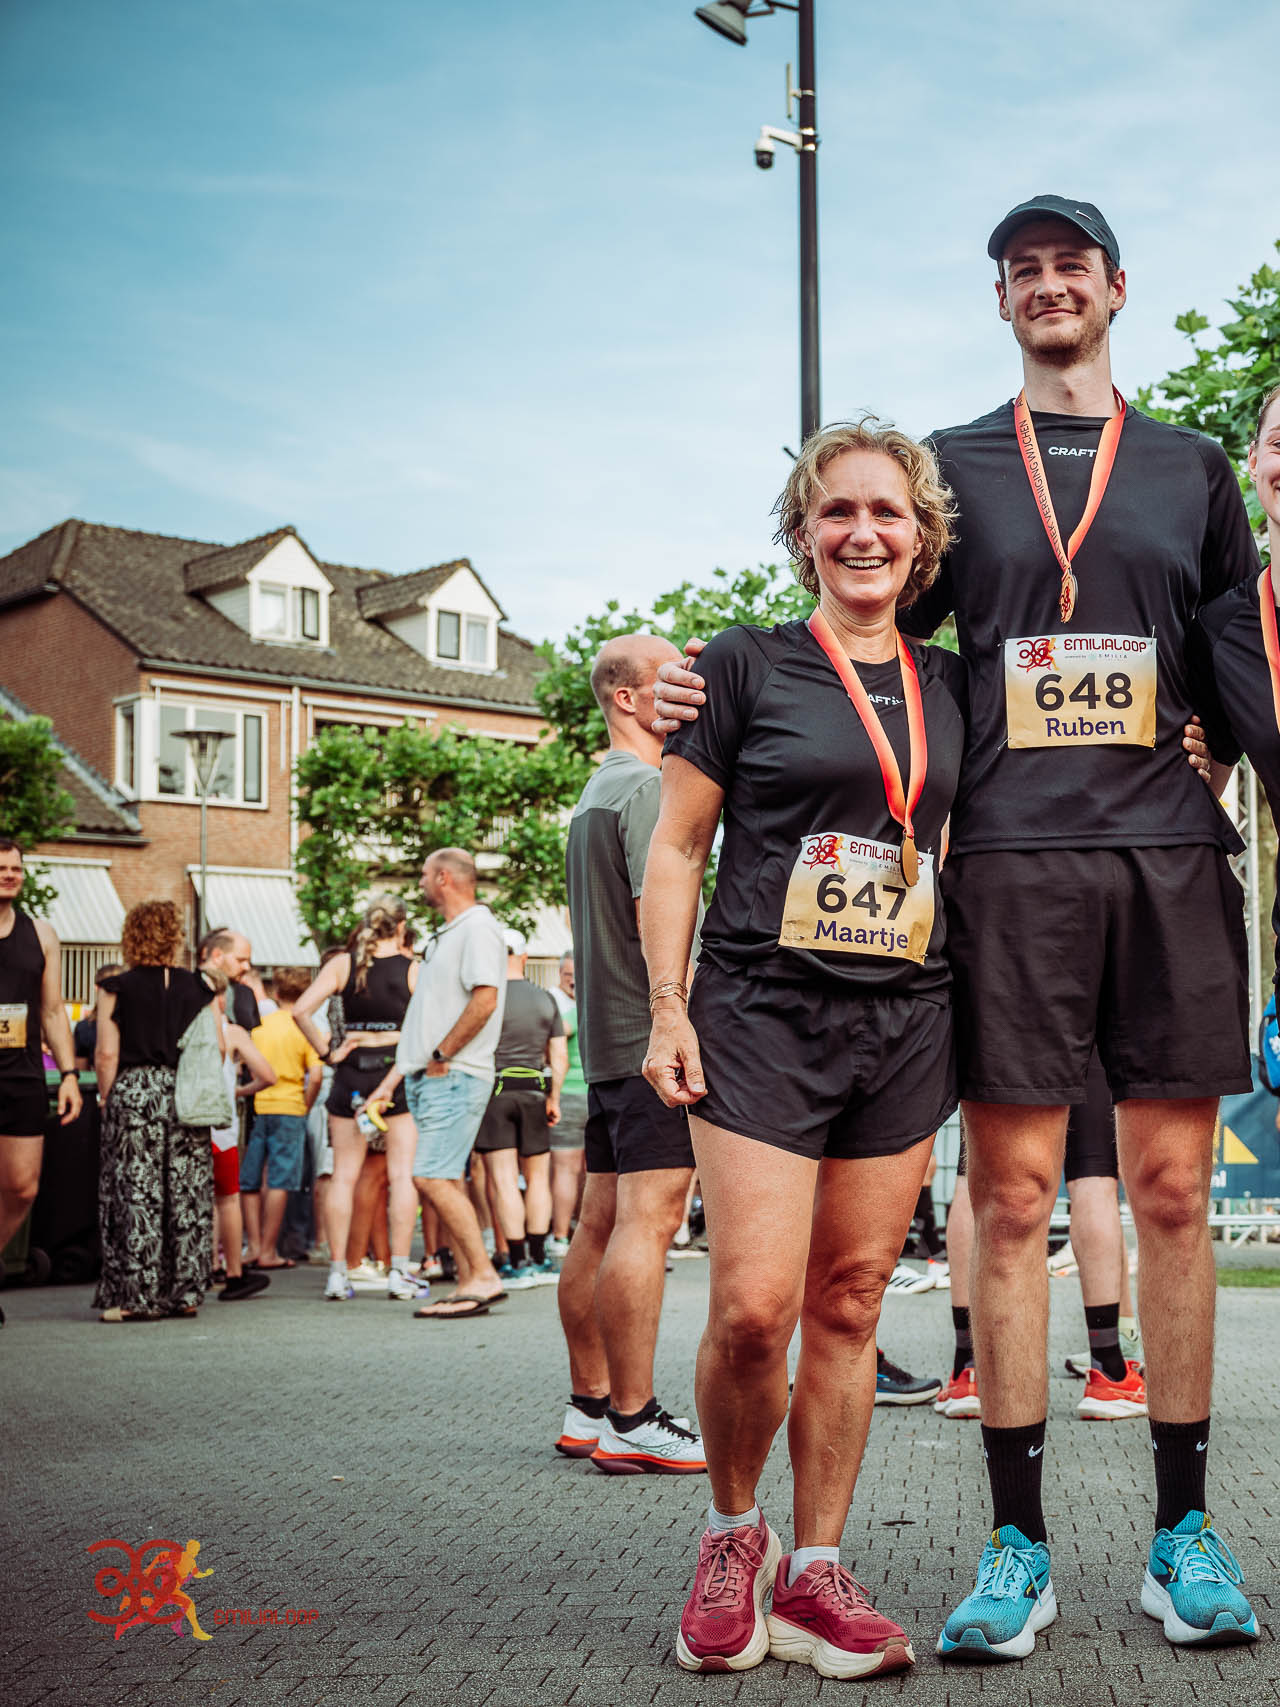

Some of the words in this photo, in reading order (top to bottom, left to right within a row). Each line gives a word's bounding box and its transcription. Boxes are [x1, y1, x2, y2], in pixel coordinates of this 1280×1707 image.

[1019, 419, 1037, 462] WIJCHEN
[1048, 446, 1096, 458] CRAFT
[1030, 462, 1052, 523] VERENIGING
[1064, 638, 1147, 653] EMILIALOOP
[1035, 672, 1133, 711] 648
[1045, 717, 1126, 737] Ruben
[816, 873, 907, 920] 647
[814, 919, 909, 953] Maartje
